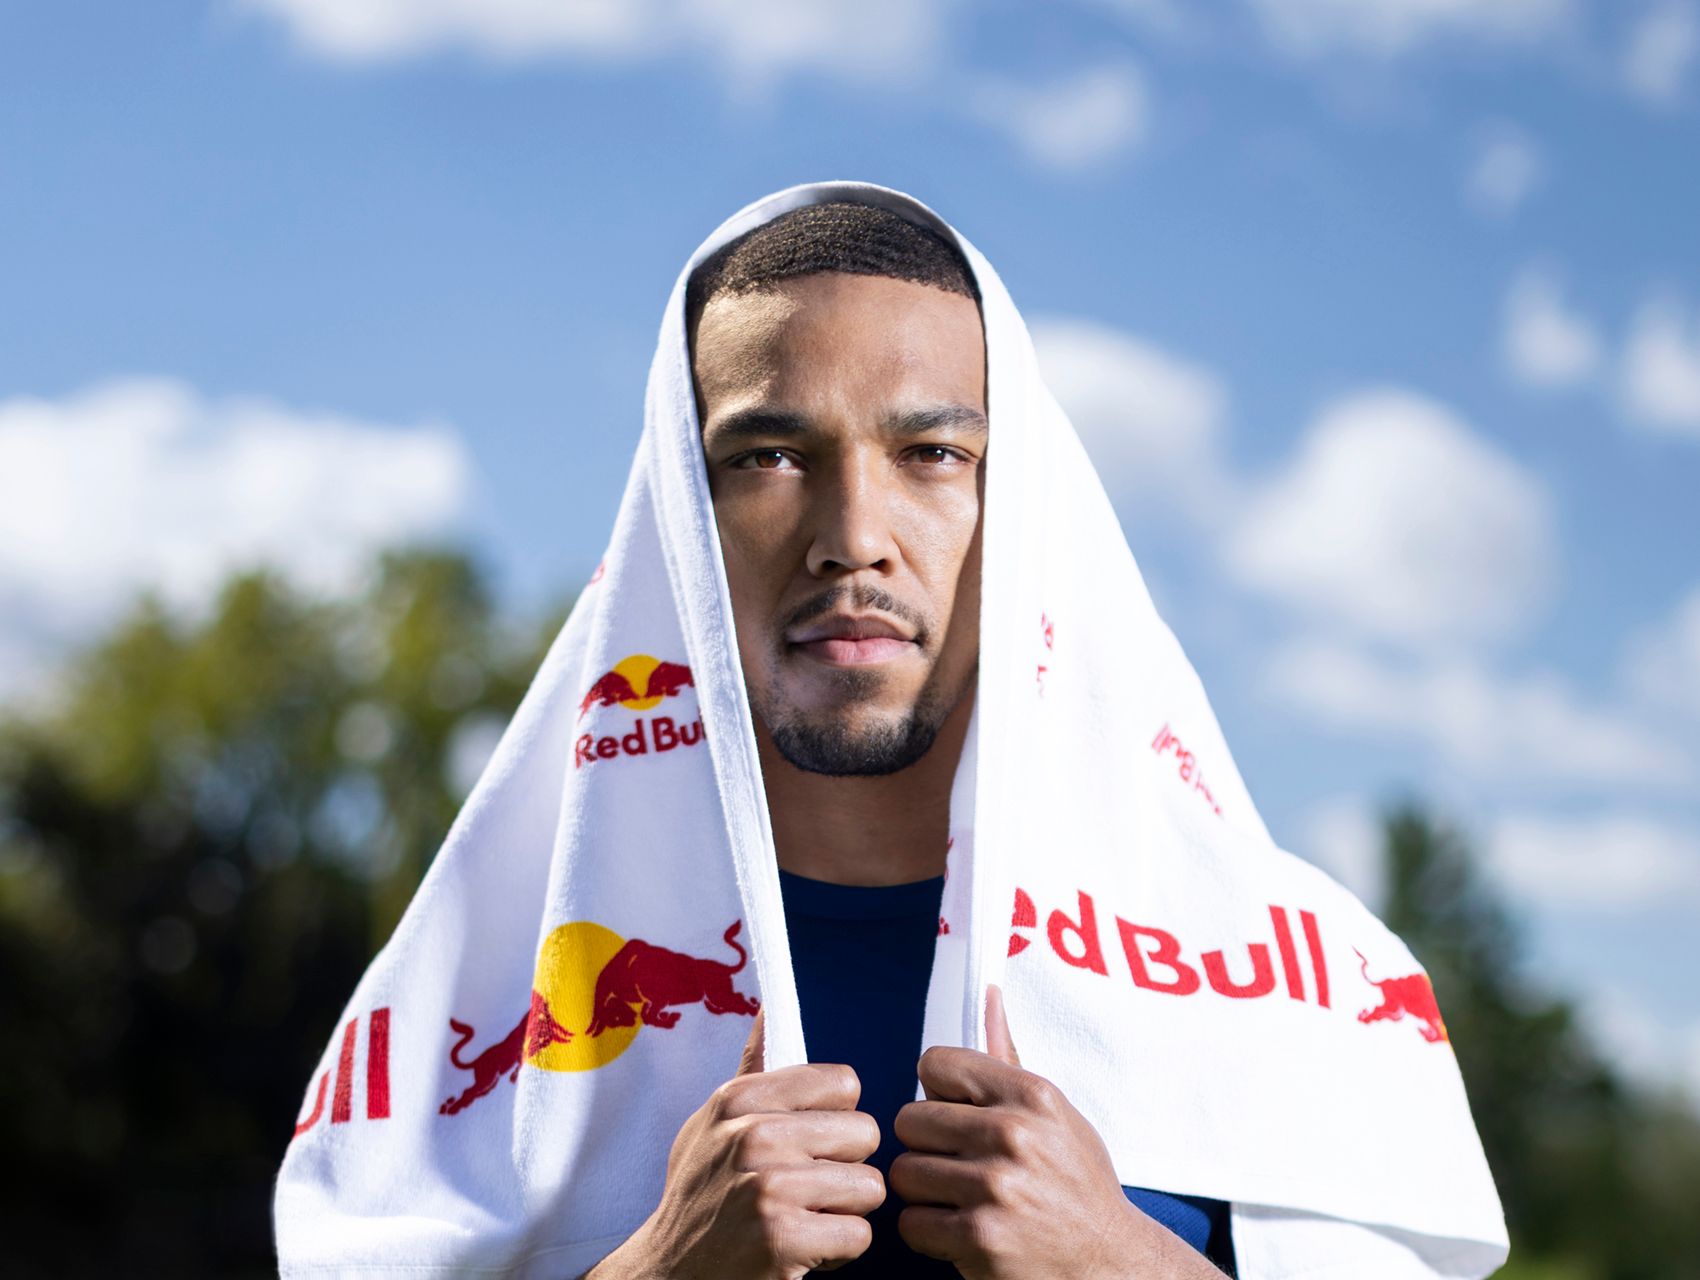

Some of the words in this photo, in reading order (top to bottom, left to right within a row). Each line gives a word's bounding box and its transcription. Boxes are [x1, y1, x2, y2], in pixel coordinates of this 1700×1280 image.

[574, 717, 648, 769] Red
[1115, 904, 1331, 1009] Bull
[293, 1006, 391, 1139] ull
